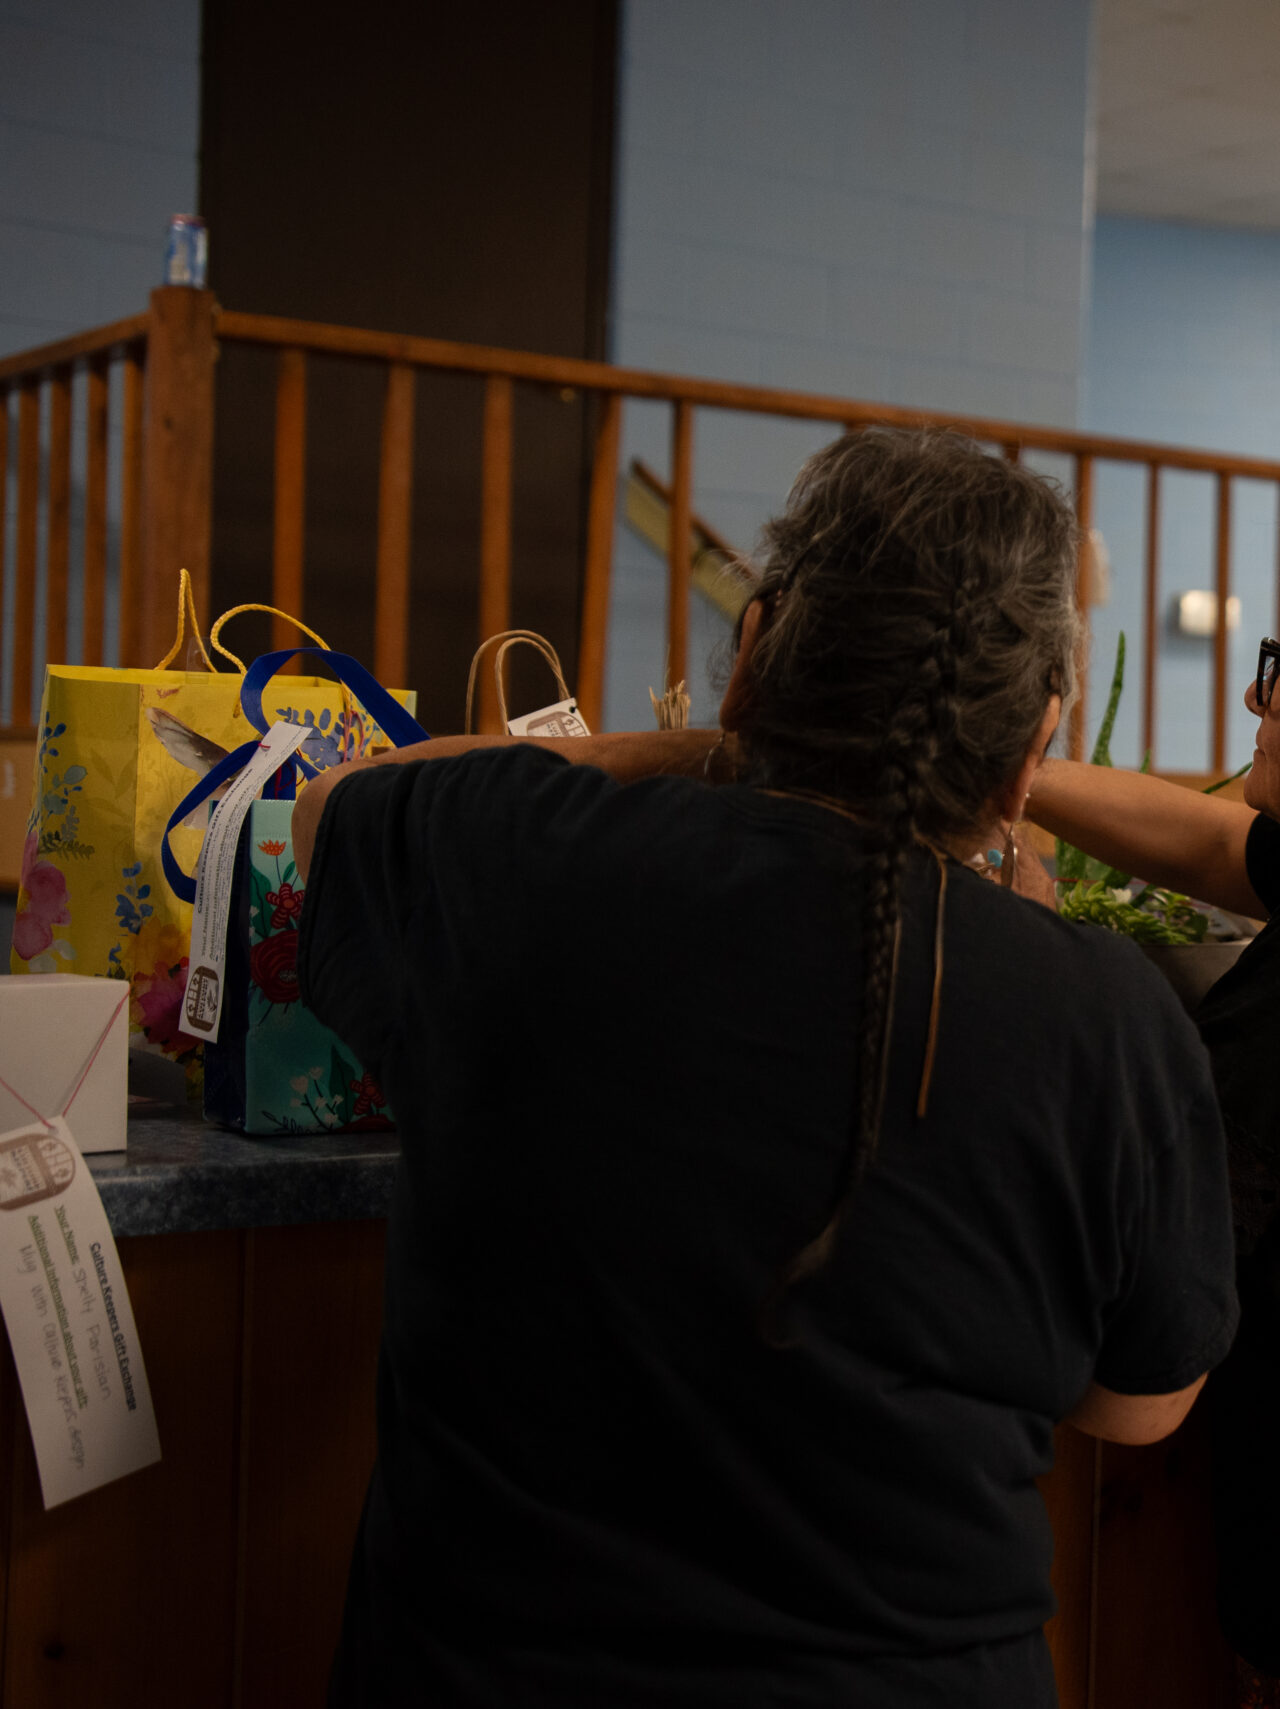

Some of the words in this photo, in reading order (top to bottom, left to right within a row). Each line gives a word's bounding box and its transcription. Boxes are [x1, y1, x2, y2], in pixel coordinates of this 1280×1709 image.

[29, 1214, 54, 1270] Additional
[55, 1205, 71, 1232] Your
[63, 1230, 82, 1266] Name:
[89, 1242, 111, 1286] Culture
[45, 1269, 69, 1327] Information
[99, 1286, 122, 1334] Keepers
[60, 1326, 78, 1360] about
[111, 1333, 128, 1358] Gift
[67, 1360, 84, 1387] your
[116, 1358, 140, 1412] Exchange
